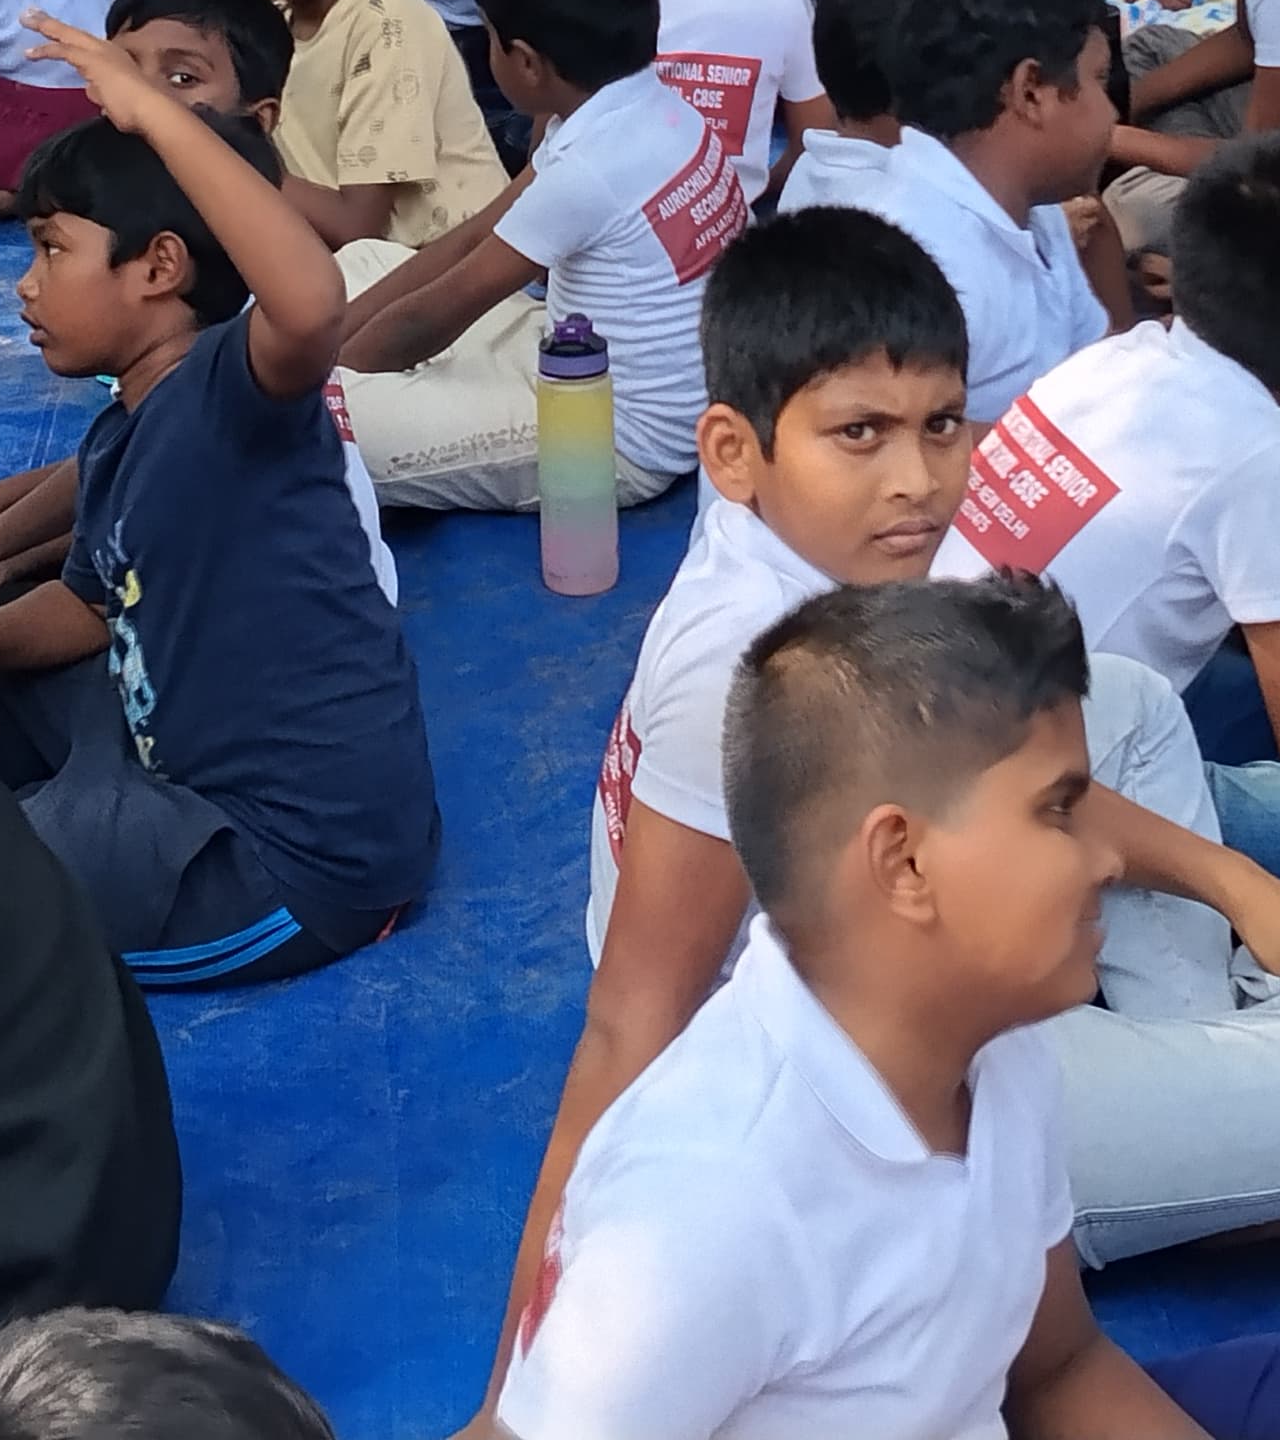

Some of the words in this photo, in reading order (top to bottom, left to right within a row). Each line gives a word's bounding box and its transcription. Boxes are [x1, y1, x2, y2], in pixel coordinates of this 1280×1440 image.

[707, 65, 751, 86] SENIOR
[658, 165, 712, 221] AUROCHILD
[1043, 454, 1099, 508] SENIOR
